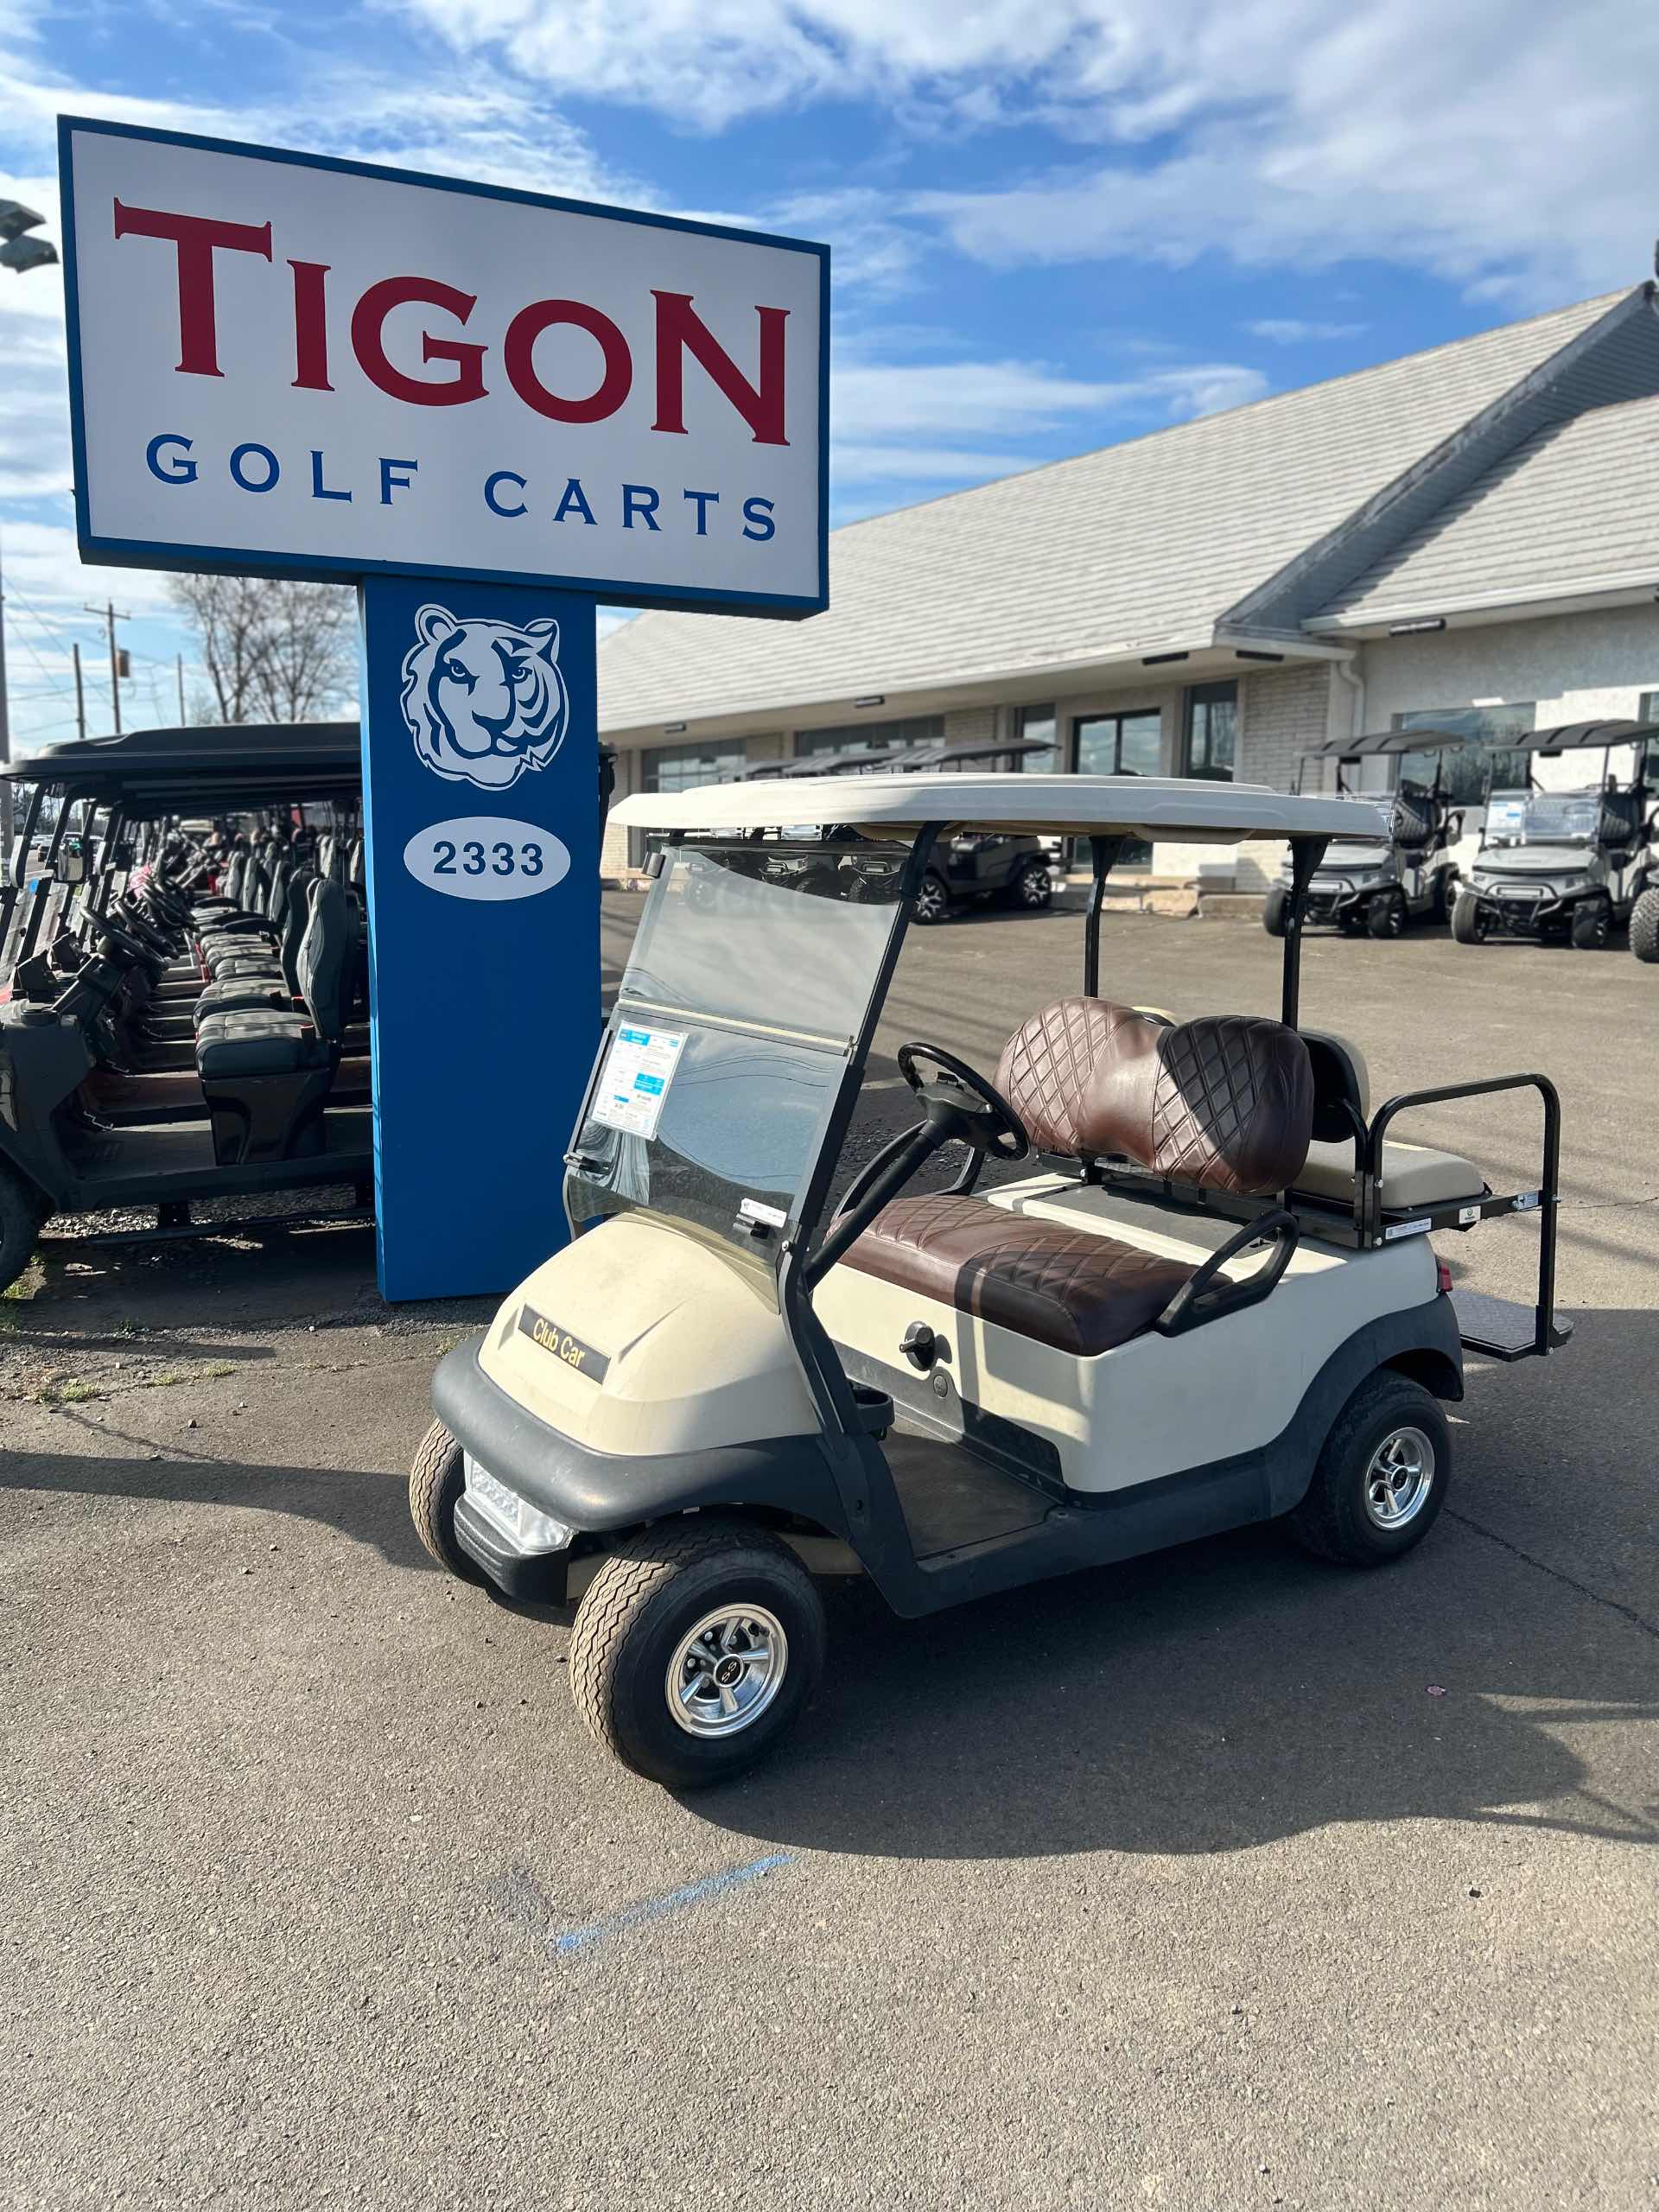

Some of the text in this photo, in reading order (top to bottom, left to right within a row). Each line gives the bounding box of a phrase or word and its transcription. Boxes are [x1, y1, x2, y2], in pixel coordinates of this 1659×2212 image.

[113, 197, 791, 447] TIGON
[146, 433, 777, 543] GOLF CARTS
[433, 840, 543, 876] 2333
[533, 1318, 586, 1367] Club Car
